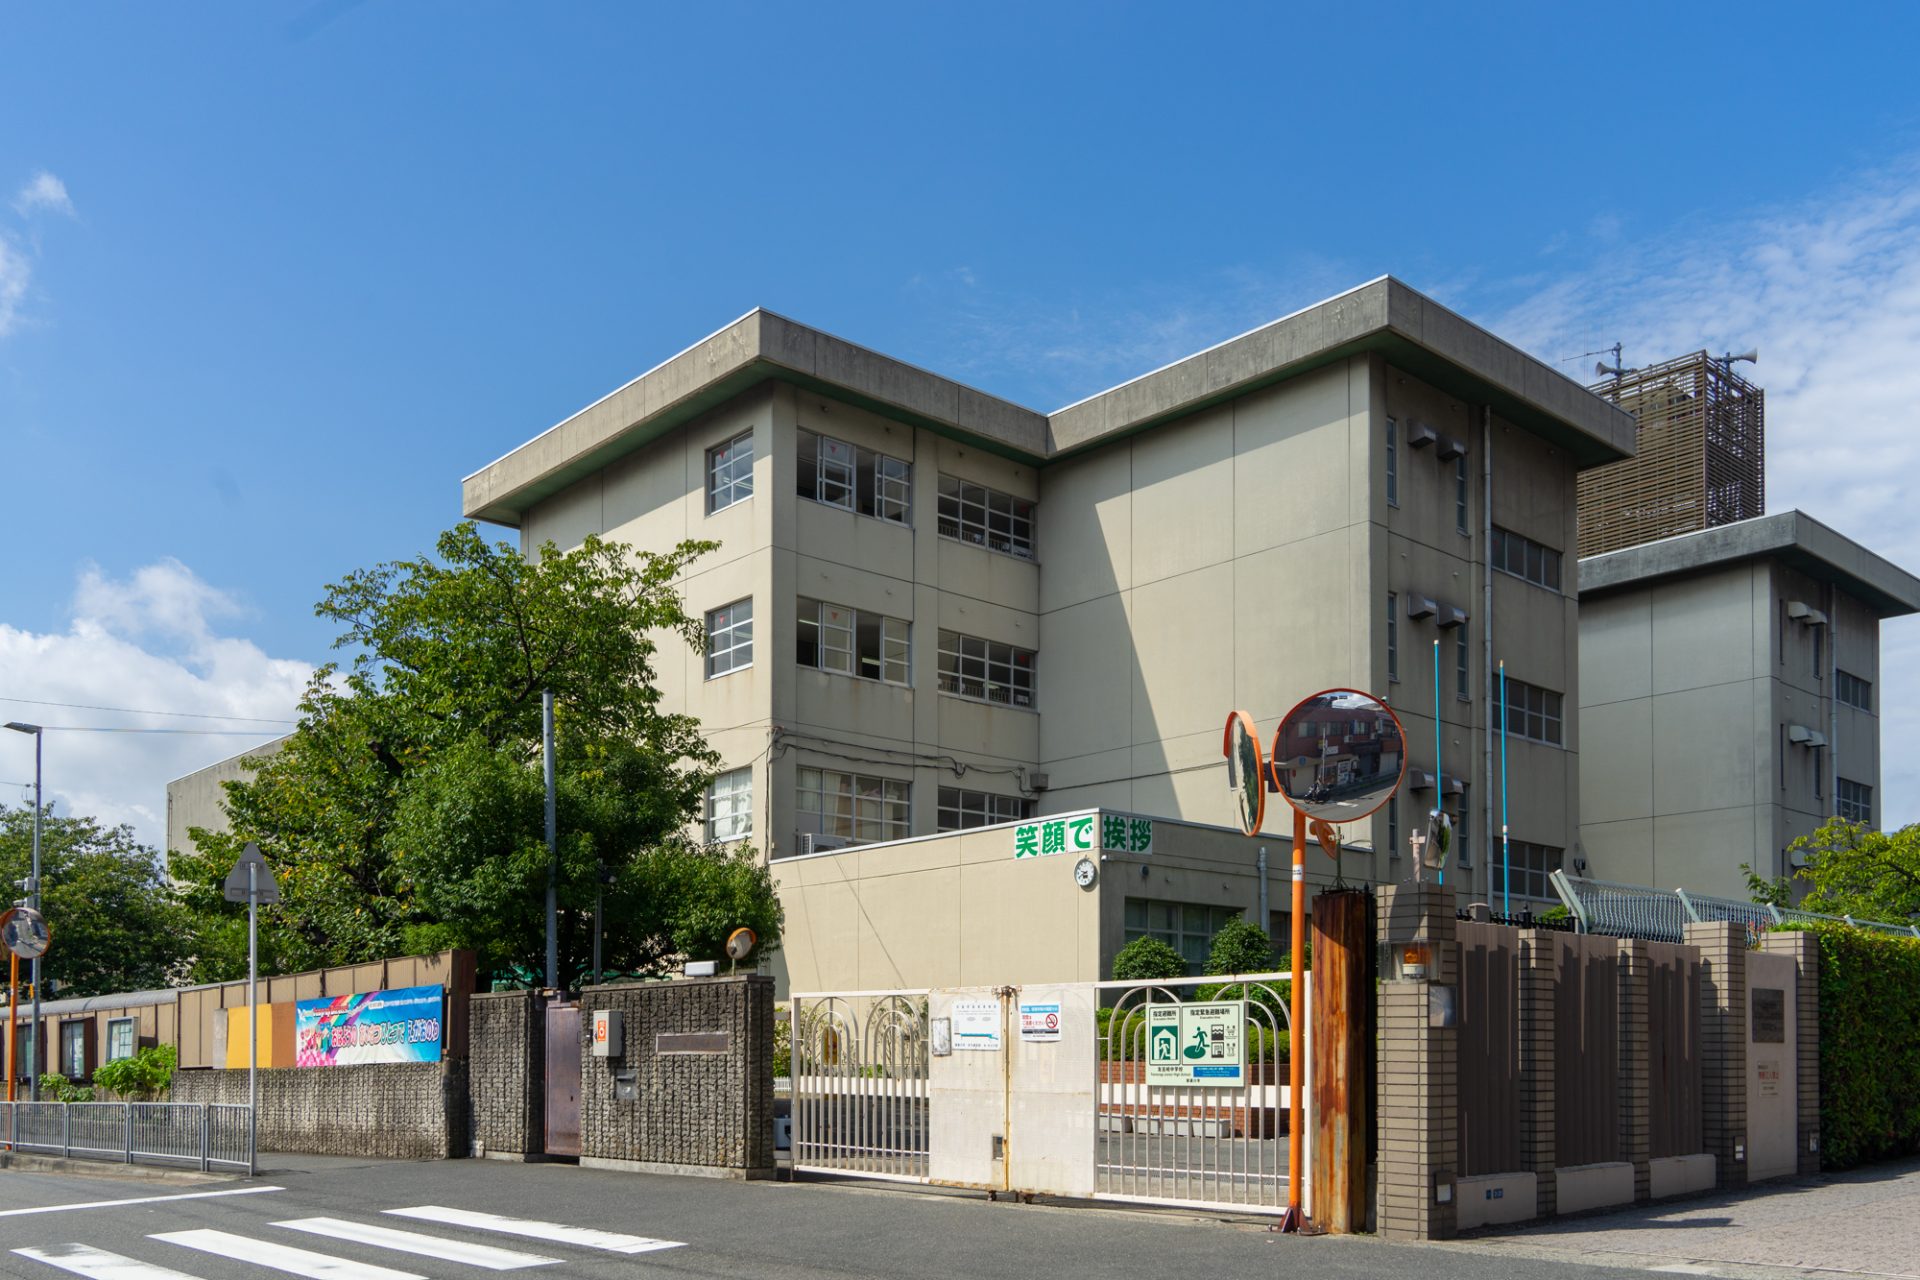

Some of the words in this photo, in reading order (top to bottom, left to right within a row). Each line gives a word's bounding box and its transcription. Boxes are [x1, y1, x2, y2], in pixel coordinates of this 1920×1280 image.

[1015, 817, 1093, 858] 笑顔で
[1103, 815, 1151, 851] 挨拶
